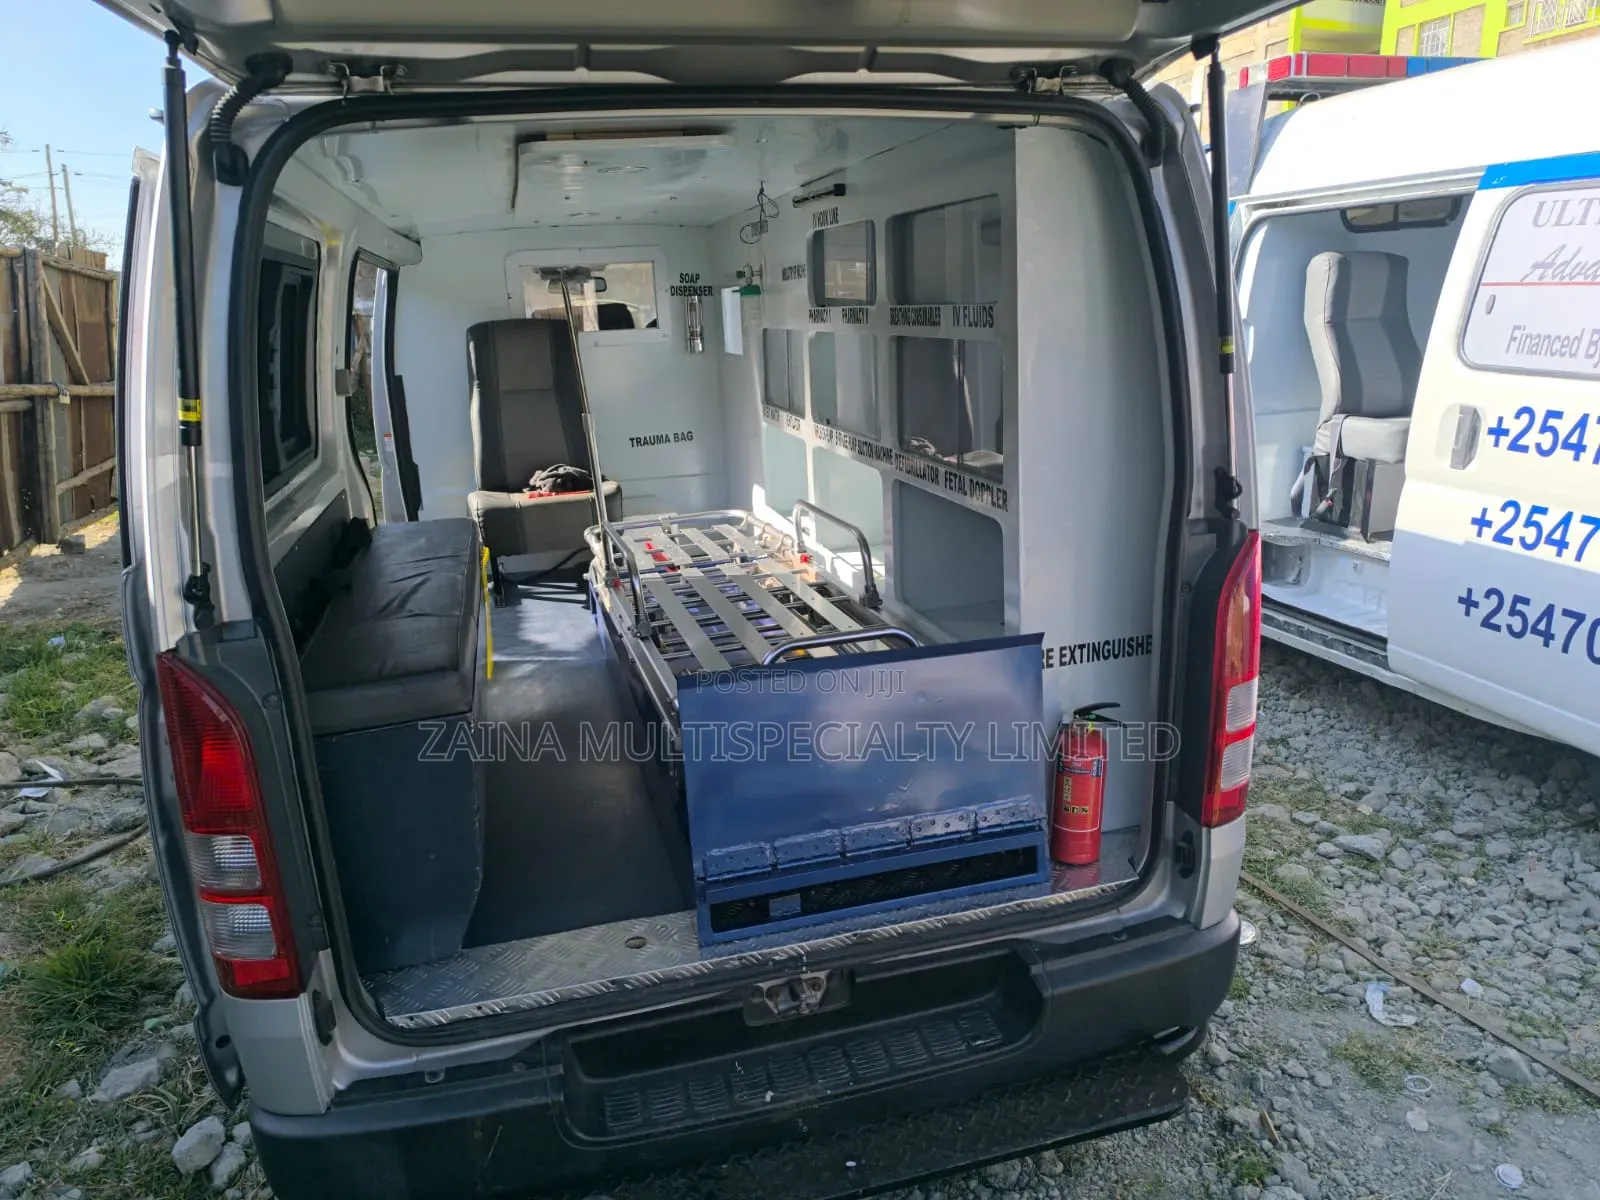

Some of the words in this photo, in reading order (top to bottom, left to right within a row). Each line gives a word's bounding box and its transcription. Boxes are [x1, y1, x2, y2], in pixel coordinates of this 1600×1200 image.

[1532, 197, 1600, 228] ULT
[670, 285, 713, 297] DISPENSER
[679, 272, 700, 284] SOAP
[952, 306, 961, 327] IV
[963, 306, 994, 328] FLUIDS
[1505, 325, 1585, 358] Financed
[629, 434, 671, 448] TRAUMA
[673, 431, 694, 443] BAG
[894, 453, 940, 486] DEFIBRILLATOR
[944, 470, 968, 496] FETAL
[969, 478, 1008, 512] DOPPLER
[1471, 500, 1600, 562] +2547
